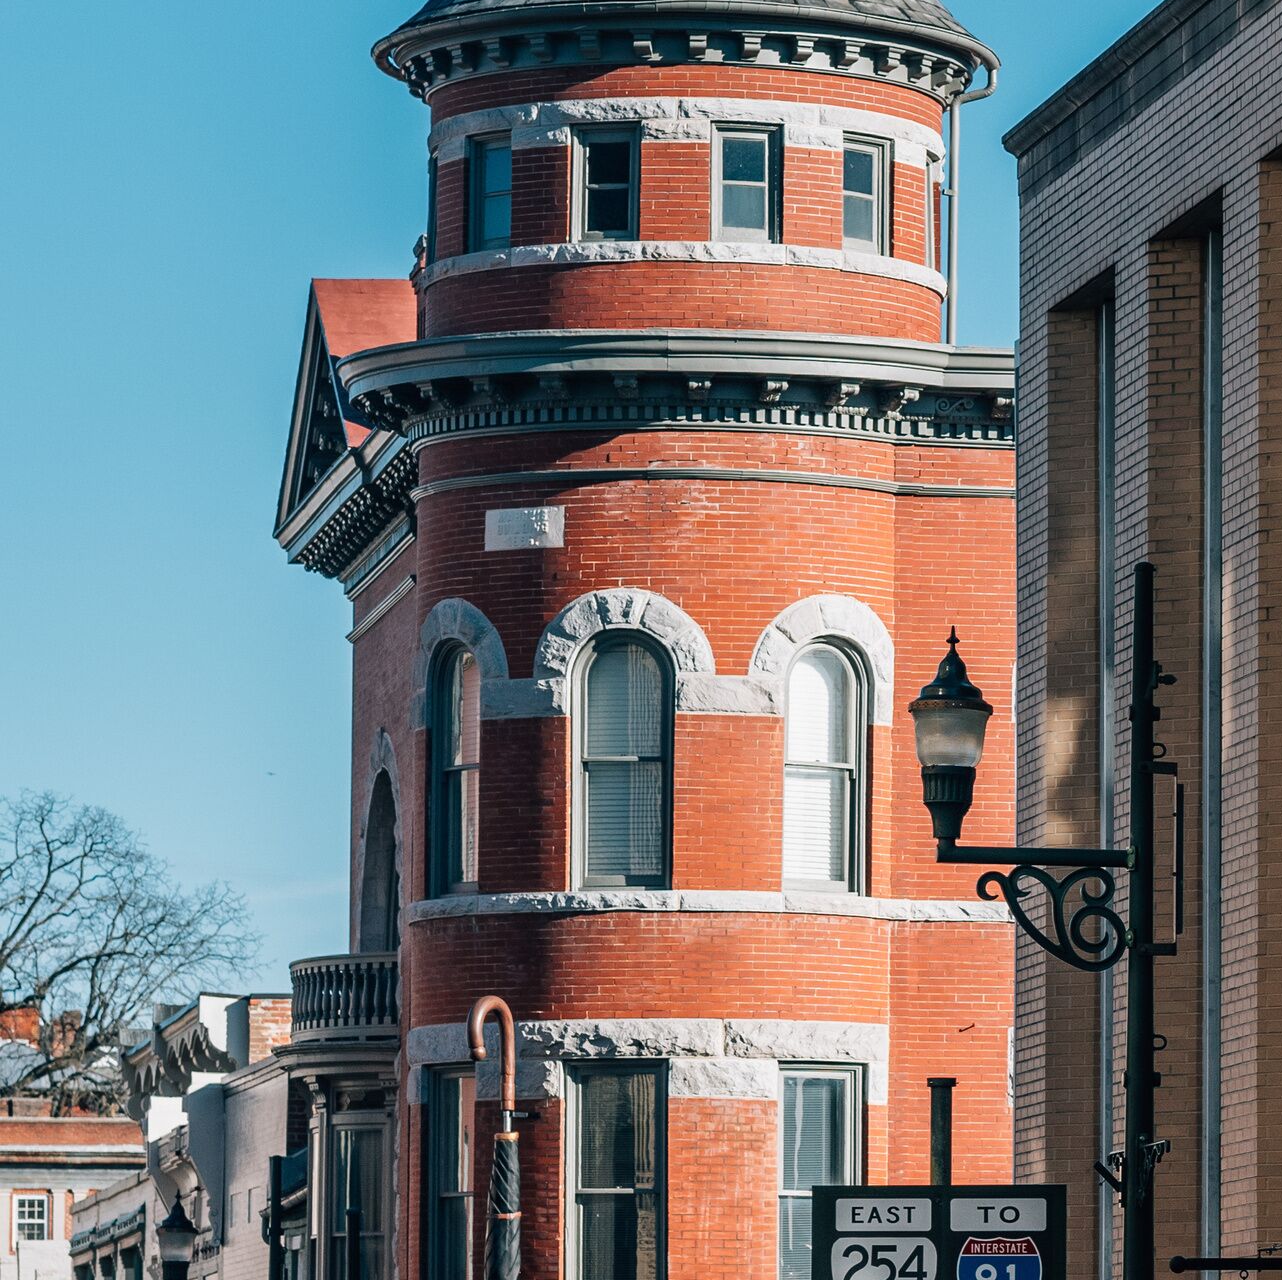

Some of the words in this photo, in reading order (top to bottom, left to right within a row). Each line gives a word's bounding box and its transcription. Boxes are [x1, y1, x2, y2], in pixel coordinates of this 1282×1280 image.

[851, 1206, 916, 1224] EAST
[977, 1206, 1020, 1224] TO
[970, 1242, 1028, 1255] INTERSTATE
